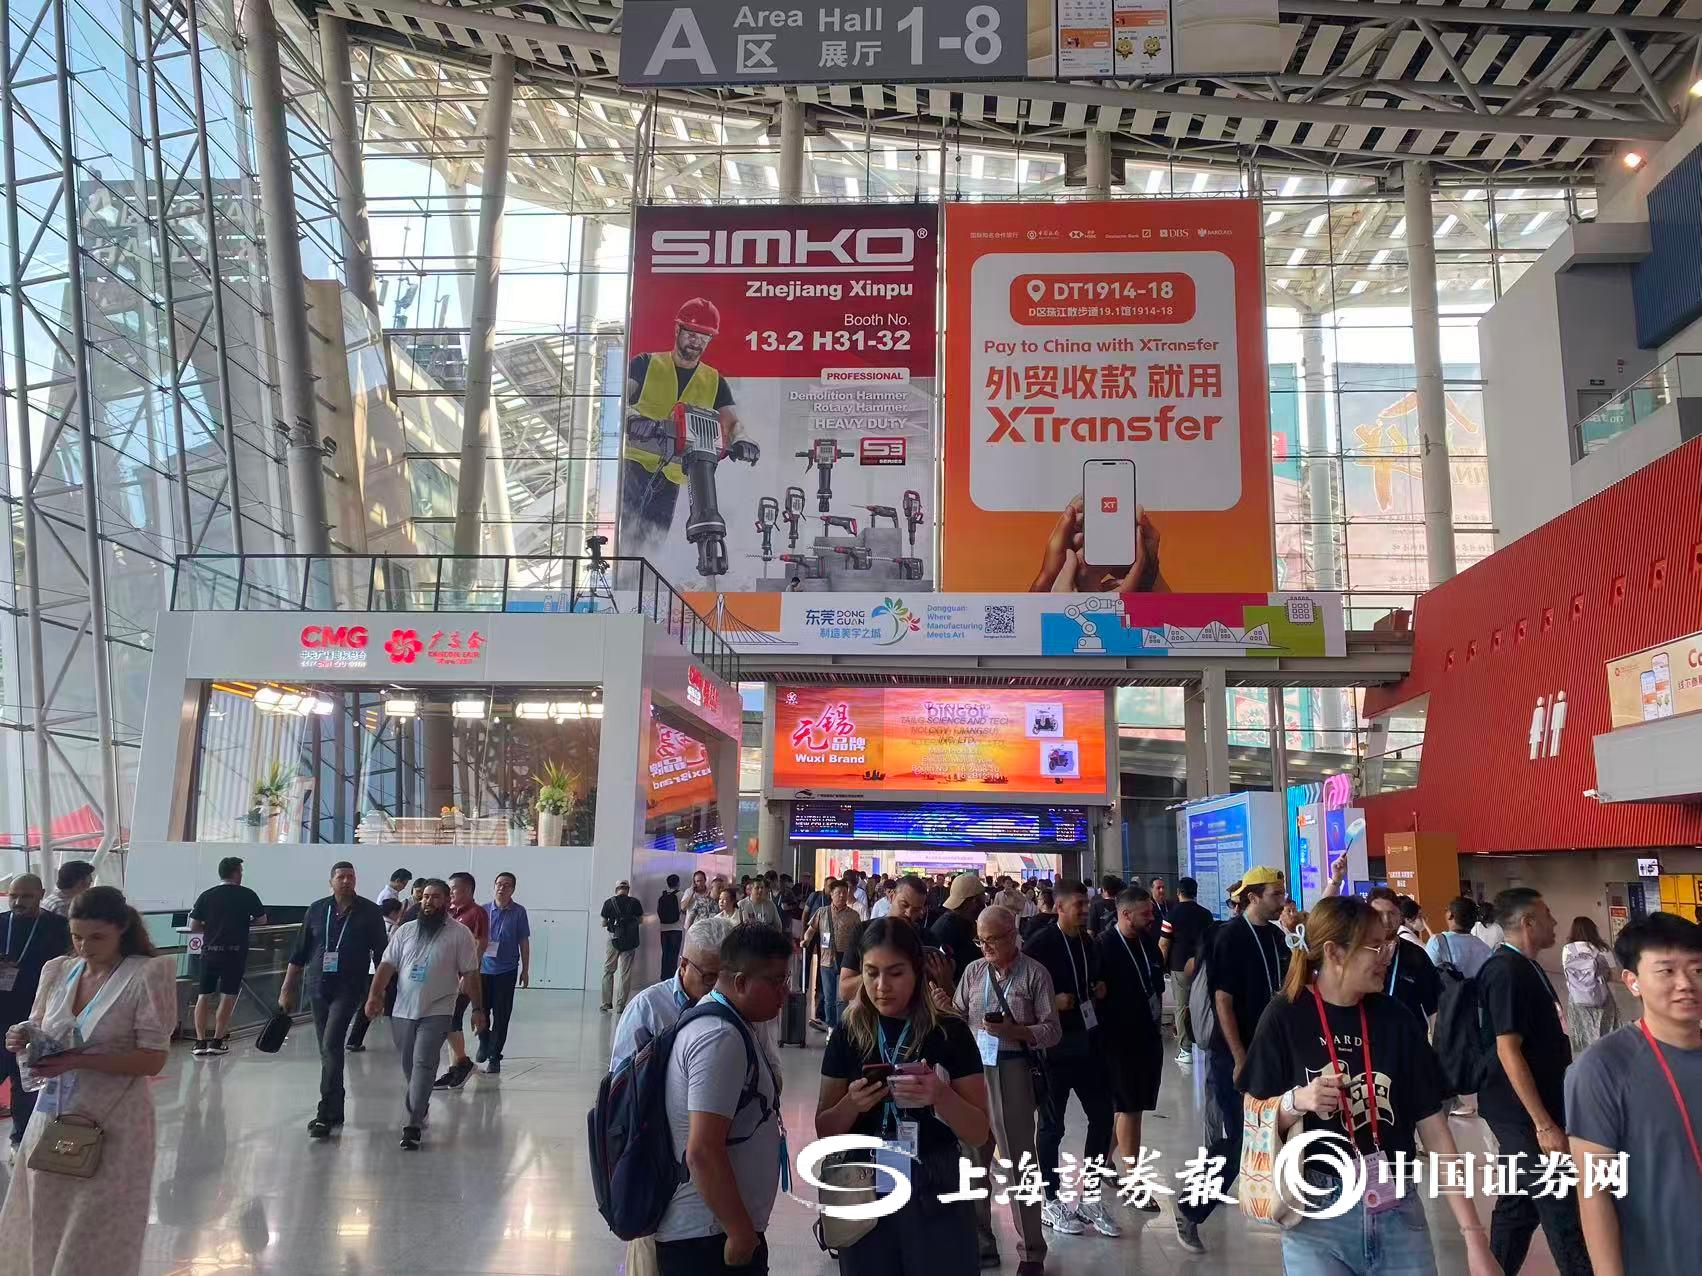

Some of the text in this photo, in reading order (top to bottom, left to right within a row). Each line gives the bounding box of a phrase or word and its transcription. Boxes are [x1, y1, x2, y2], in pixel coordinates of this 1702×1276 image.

[643, 5, 1002, 75] A Area Hall 1-8
[736, 34, 882, 73] 区 展厅
[1169, 229, 1189, 238] DBS
[651, 228, 914, 265] SIMKO
[745, 280, 913, 301] Zhejiang Xinpu
[1054, 281, 1174, 300] DT1914-18
[844, 313, 911, 326] Booth No.
[745, 330, 912, 351] 13.2 H31-32
[984, 337, 1220, 357] Pay to China with XTransfer
[827, 372, 904, 381] PROFESSIONAL
[985, 363, 1223, 400] 外贸收款 就用
[790, 390, 908, 401] Demolition Hammer
[813, 402, 908, 414] Rotary Hammer
[815, 418, 908, 430] HEAVY DUTY
[985, 405, 1224, 443] XTransfer
[1103, 501, 1116, 509] XT
[836, 610, 866, 618] DONG
[927, 604, 968, 614] Dongguan:
[805, 609, 835, 626] 东莞
[836, 618, 865, 626] GUAN
[927, 613, 952, 621] Where
[927, 622, 983, 632] Manufacturing
[300, 625, 369, 649] CMG
[820, 628, 881, 639] 制造美学之城
[927, 631, 965, 639] Meets Art
[793, 703, 855, 750] 无锡
[831, 736, 866, 751] 品牌
[795, 754, 865, 763] Wuxi Brand
